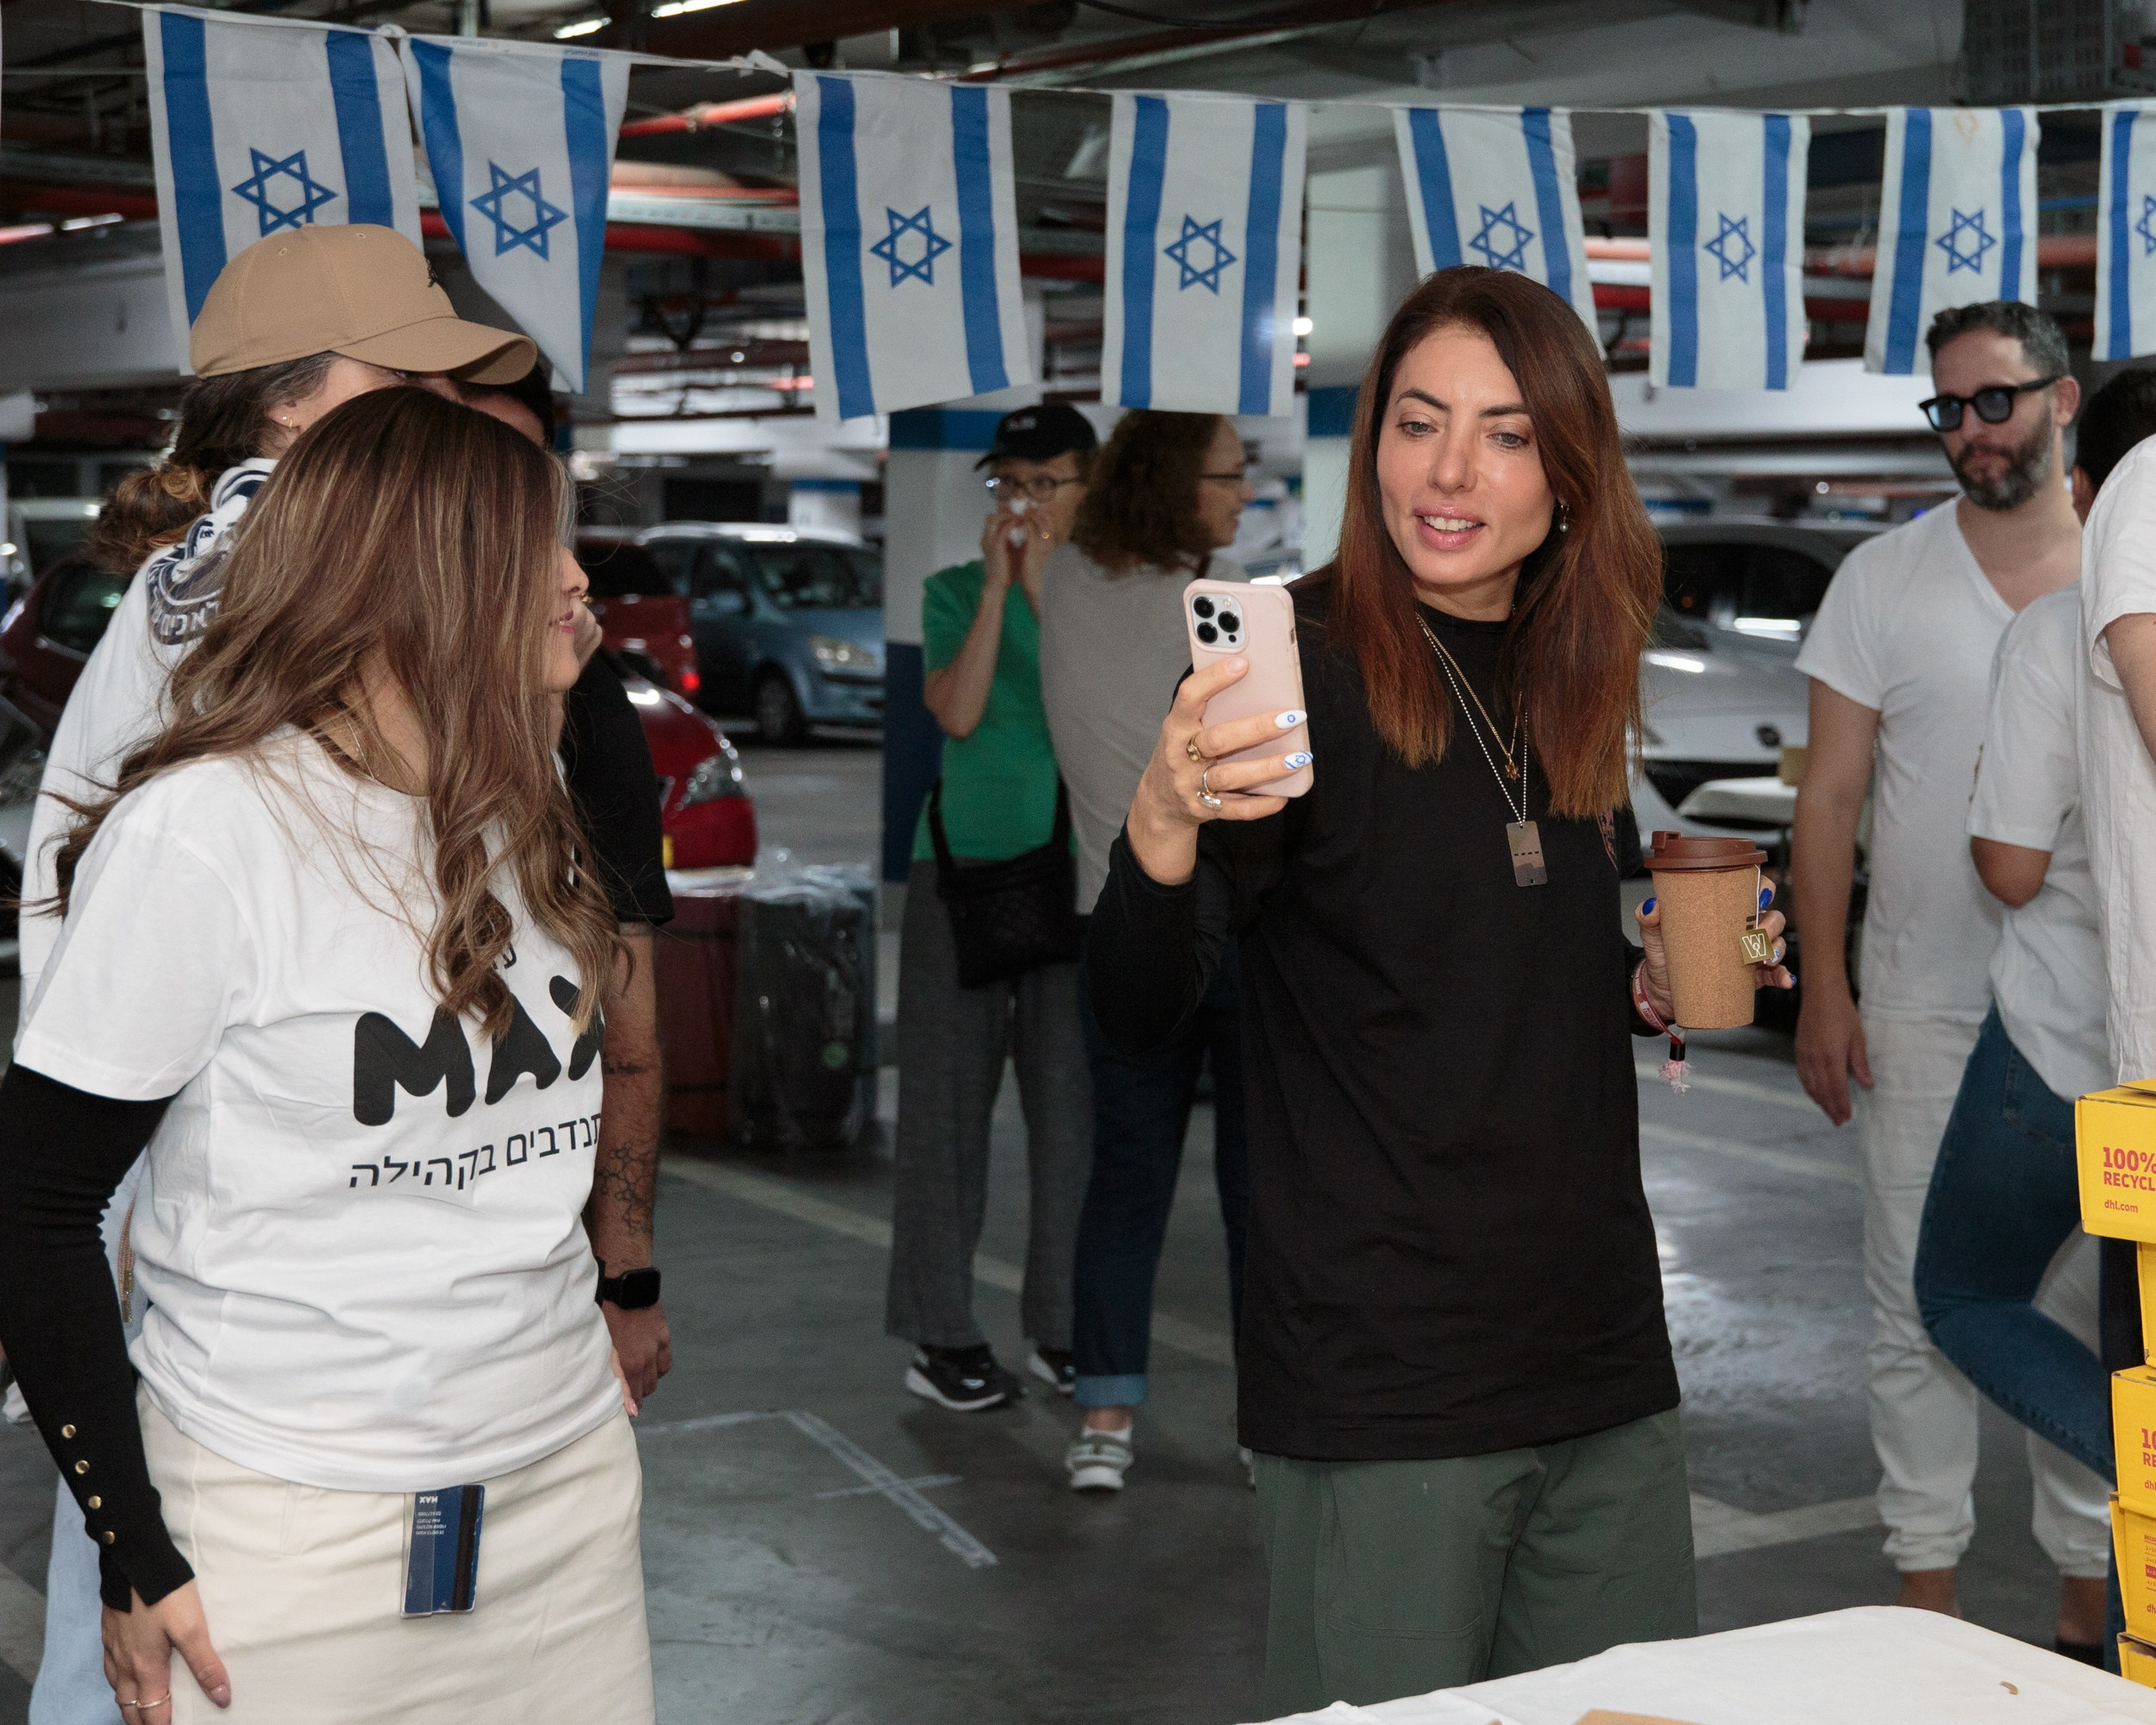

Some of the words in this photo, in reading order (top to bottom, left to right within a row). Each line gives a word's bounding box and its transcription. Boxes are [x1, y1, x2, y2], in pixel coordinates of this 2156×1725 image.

[349, 1144, 497, 1190] בקהילה
[2103, 1146, 2156, 1175] 100%
[2103, 1170, 2156, 1192] RECYCL
[2104, 1199, 2139, 1214] dhl.com
